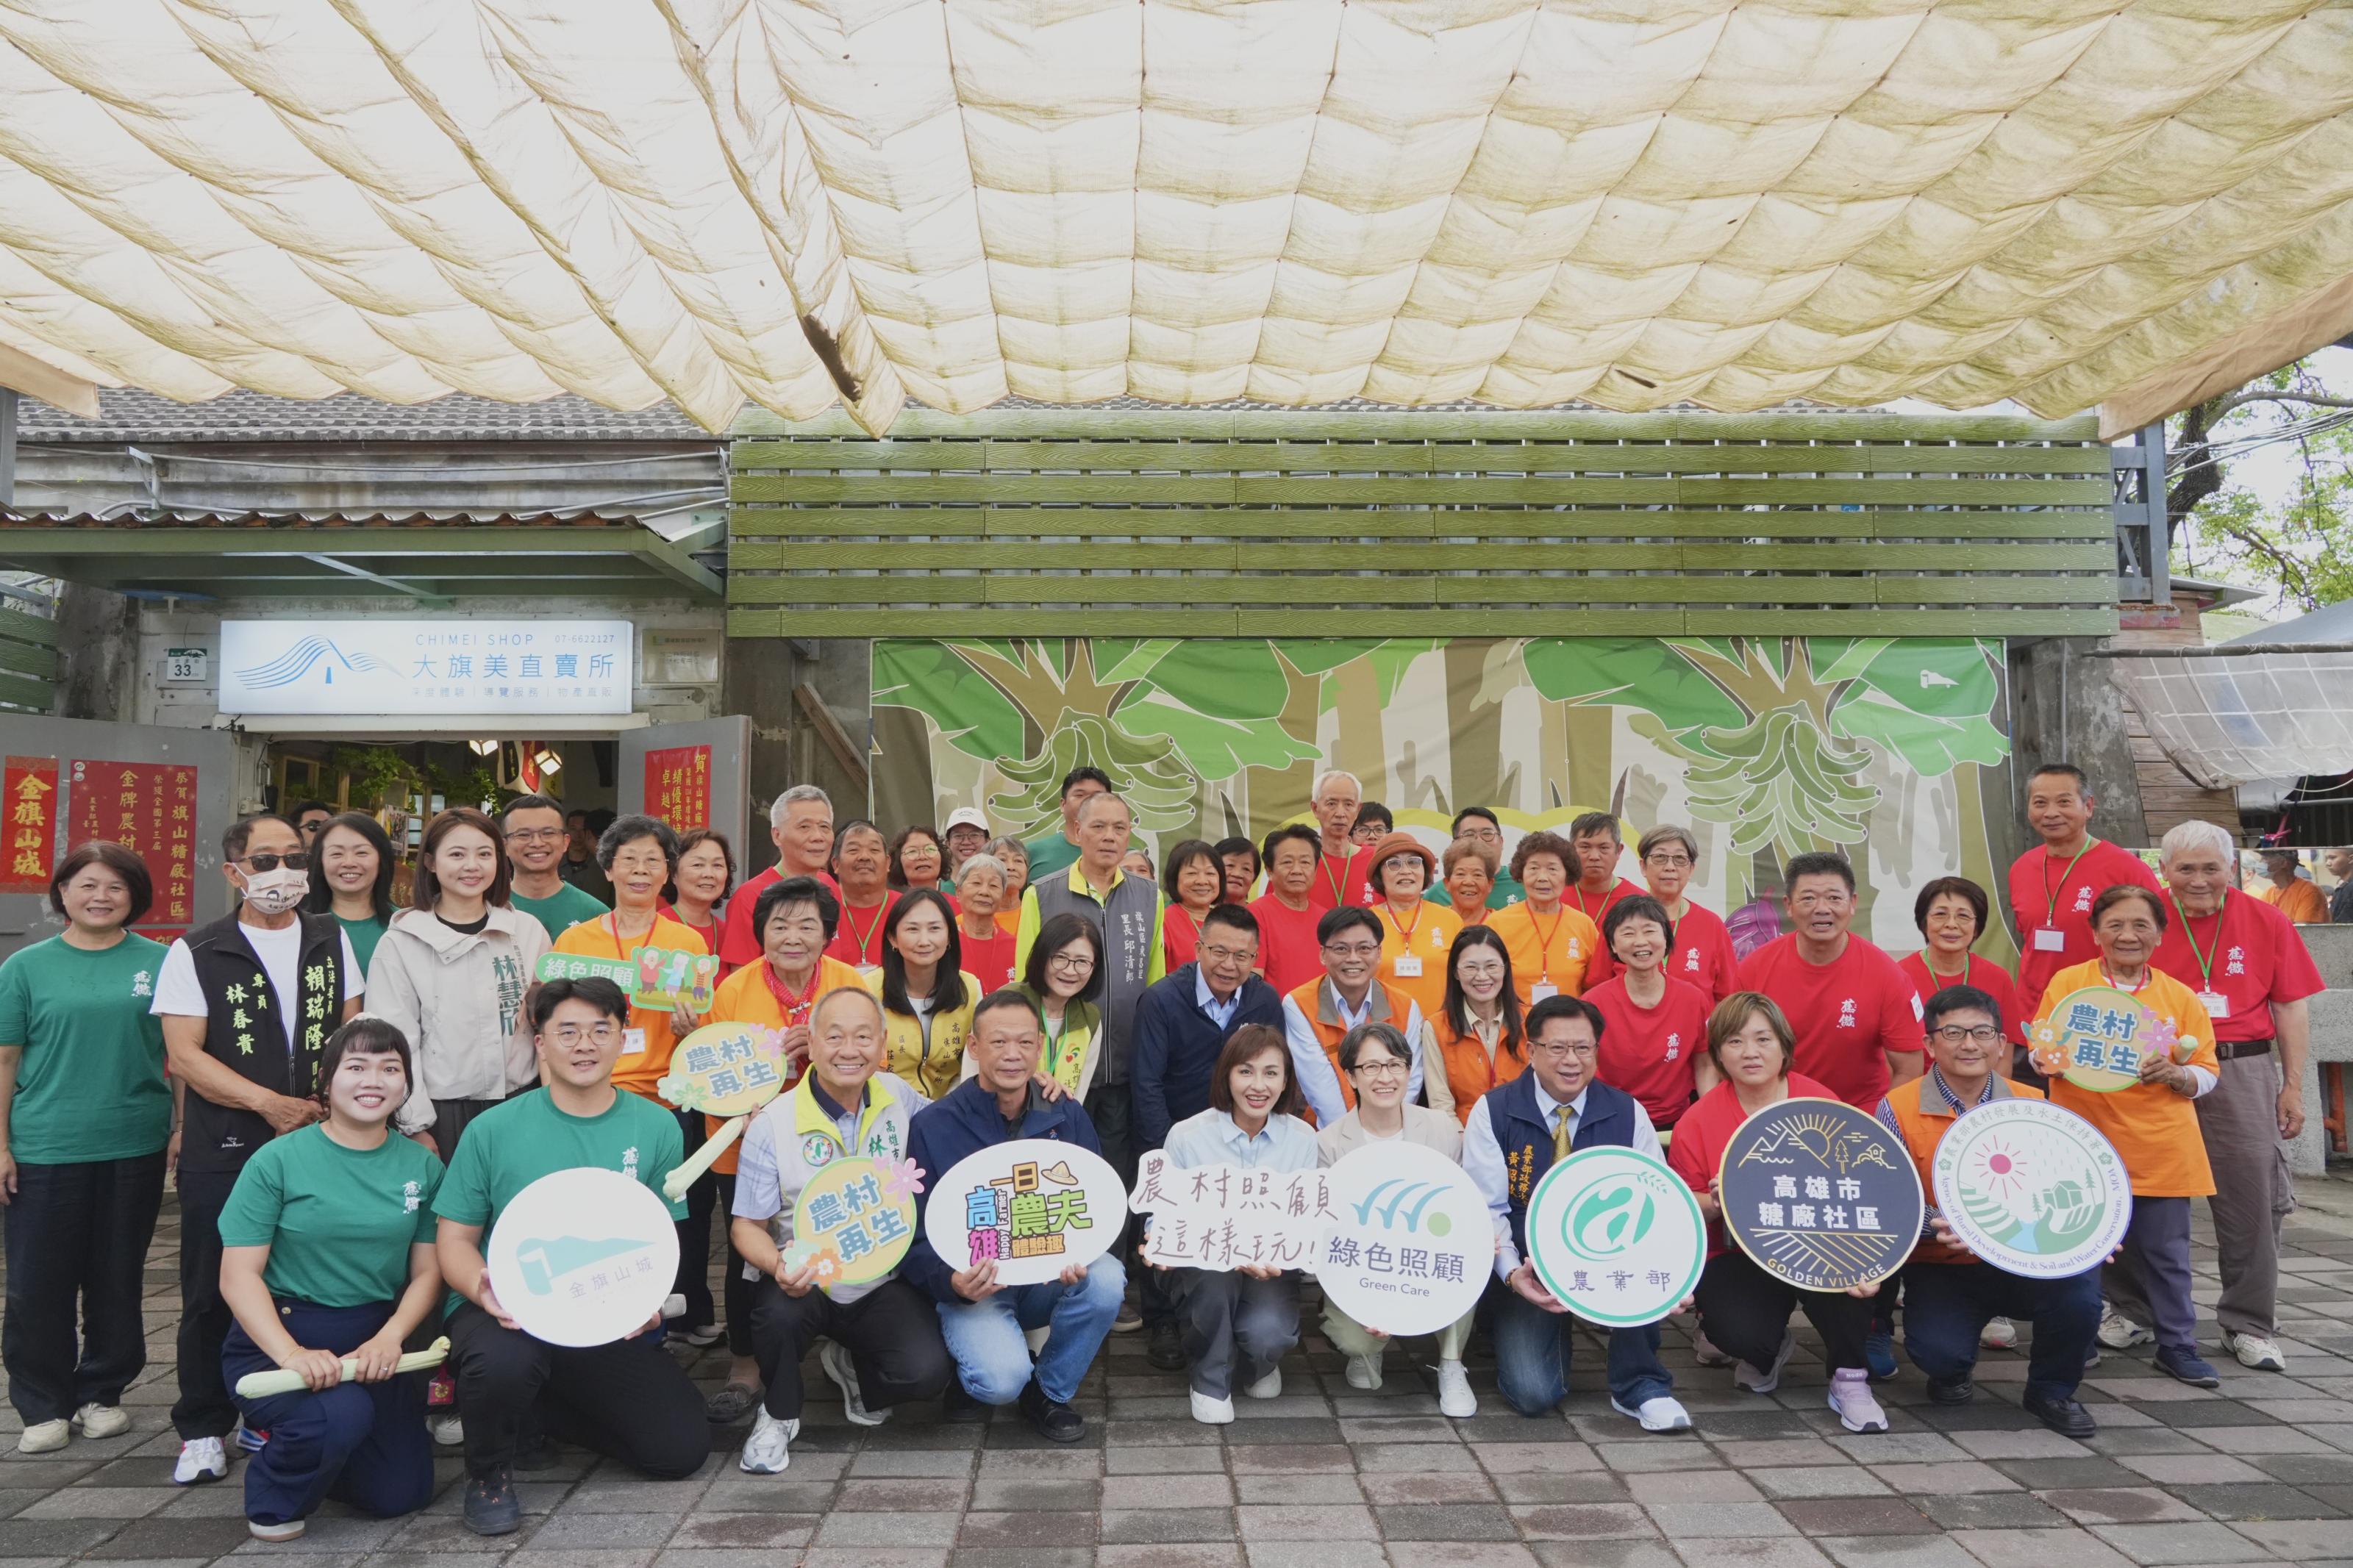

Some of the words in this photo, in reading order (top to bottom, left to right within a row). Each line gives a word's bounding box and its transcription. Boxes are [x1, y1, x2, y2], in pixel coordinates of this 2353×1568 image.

[415, 634, 476, 645] CHIMEI
[488, 634, 533, 645] SHOP
[554, 635, 615, 643] 07-6622127
[174, 665, 191, 676] 33
[412, 654, 615, 678] 大旗美直賣所
[10, 773, 52, 877] 金旗山城
[251, 973, 267, 1010] 專員
[544, 958, 635, 988] 綠色照顧
[226, 983, 254, 1056] 林春貴
[304, 965, 326, 1050] 賴瑞隆
[2067, 1003, 2135, 1040] 農村
[685, 1034, 754, 1073] 農村
[2074, 1038, 2139, 1075] 再生
[708, 1062, 779, 1097] 再生
[868, 1134, 888, 1158] 林
[990, 1161, 1039, 1192] 一日
[1137, 1156, 1338, 1221] 農村照顧
[1519, 1145, 1534, 1206] 農業部政務次
[1773, 1175, 1861, 1201] 高雄市
[808, 1174, 881, 1232] 農村
[997, 1188, 1010, 1226] Farmer
[1010, 1189, 1093, 1238] 農夫
[1758, 1202, 1881, 1231] 糖廠社區
[835, 1209, 910, 1261] 再生
[965, 1185, 999, 1267] 高雄
[1941, 1175, 1952, 1204] Agency
[1955, 1214, 1974, 1237] Rural
[1972, 1234, 2029, 1269] Development
[2030, 1262, 2038, 1270] &
[2039, 1260, 2057, 1270] Soil
[2058, 1257, 2074, 1268] and
[2074, 1247, 2098, 1264] Water
[999, 1228, 1012, 1261] Happy
[1011, 1234, 1065, 1259] 體驗趣
[1328, 1236, 1465, 1284] 綠色照顧
[569, 1256, 653, 1299] 金旗山城
[1359, 1277, 1396, 1292] Green
[1400, 1283, 1430, 1297] Care
[1569, 1270, 1671, 1292] 農業部
[1760, 1258, 1824, 1286] GOLDEN
[1829, 1263, 1886, 1286] VILLAGE
